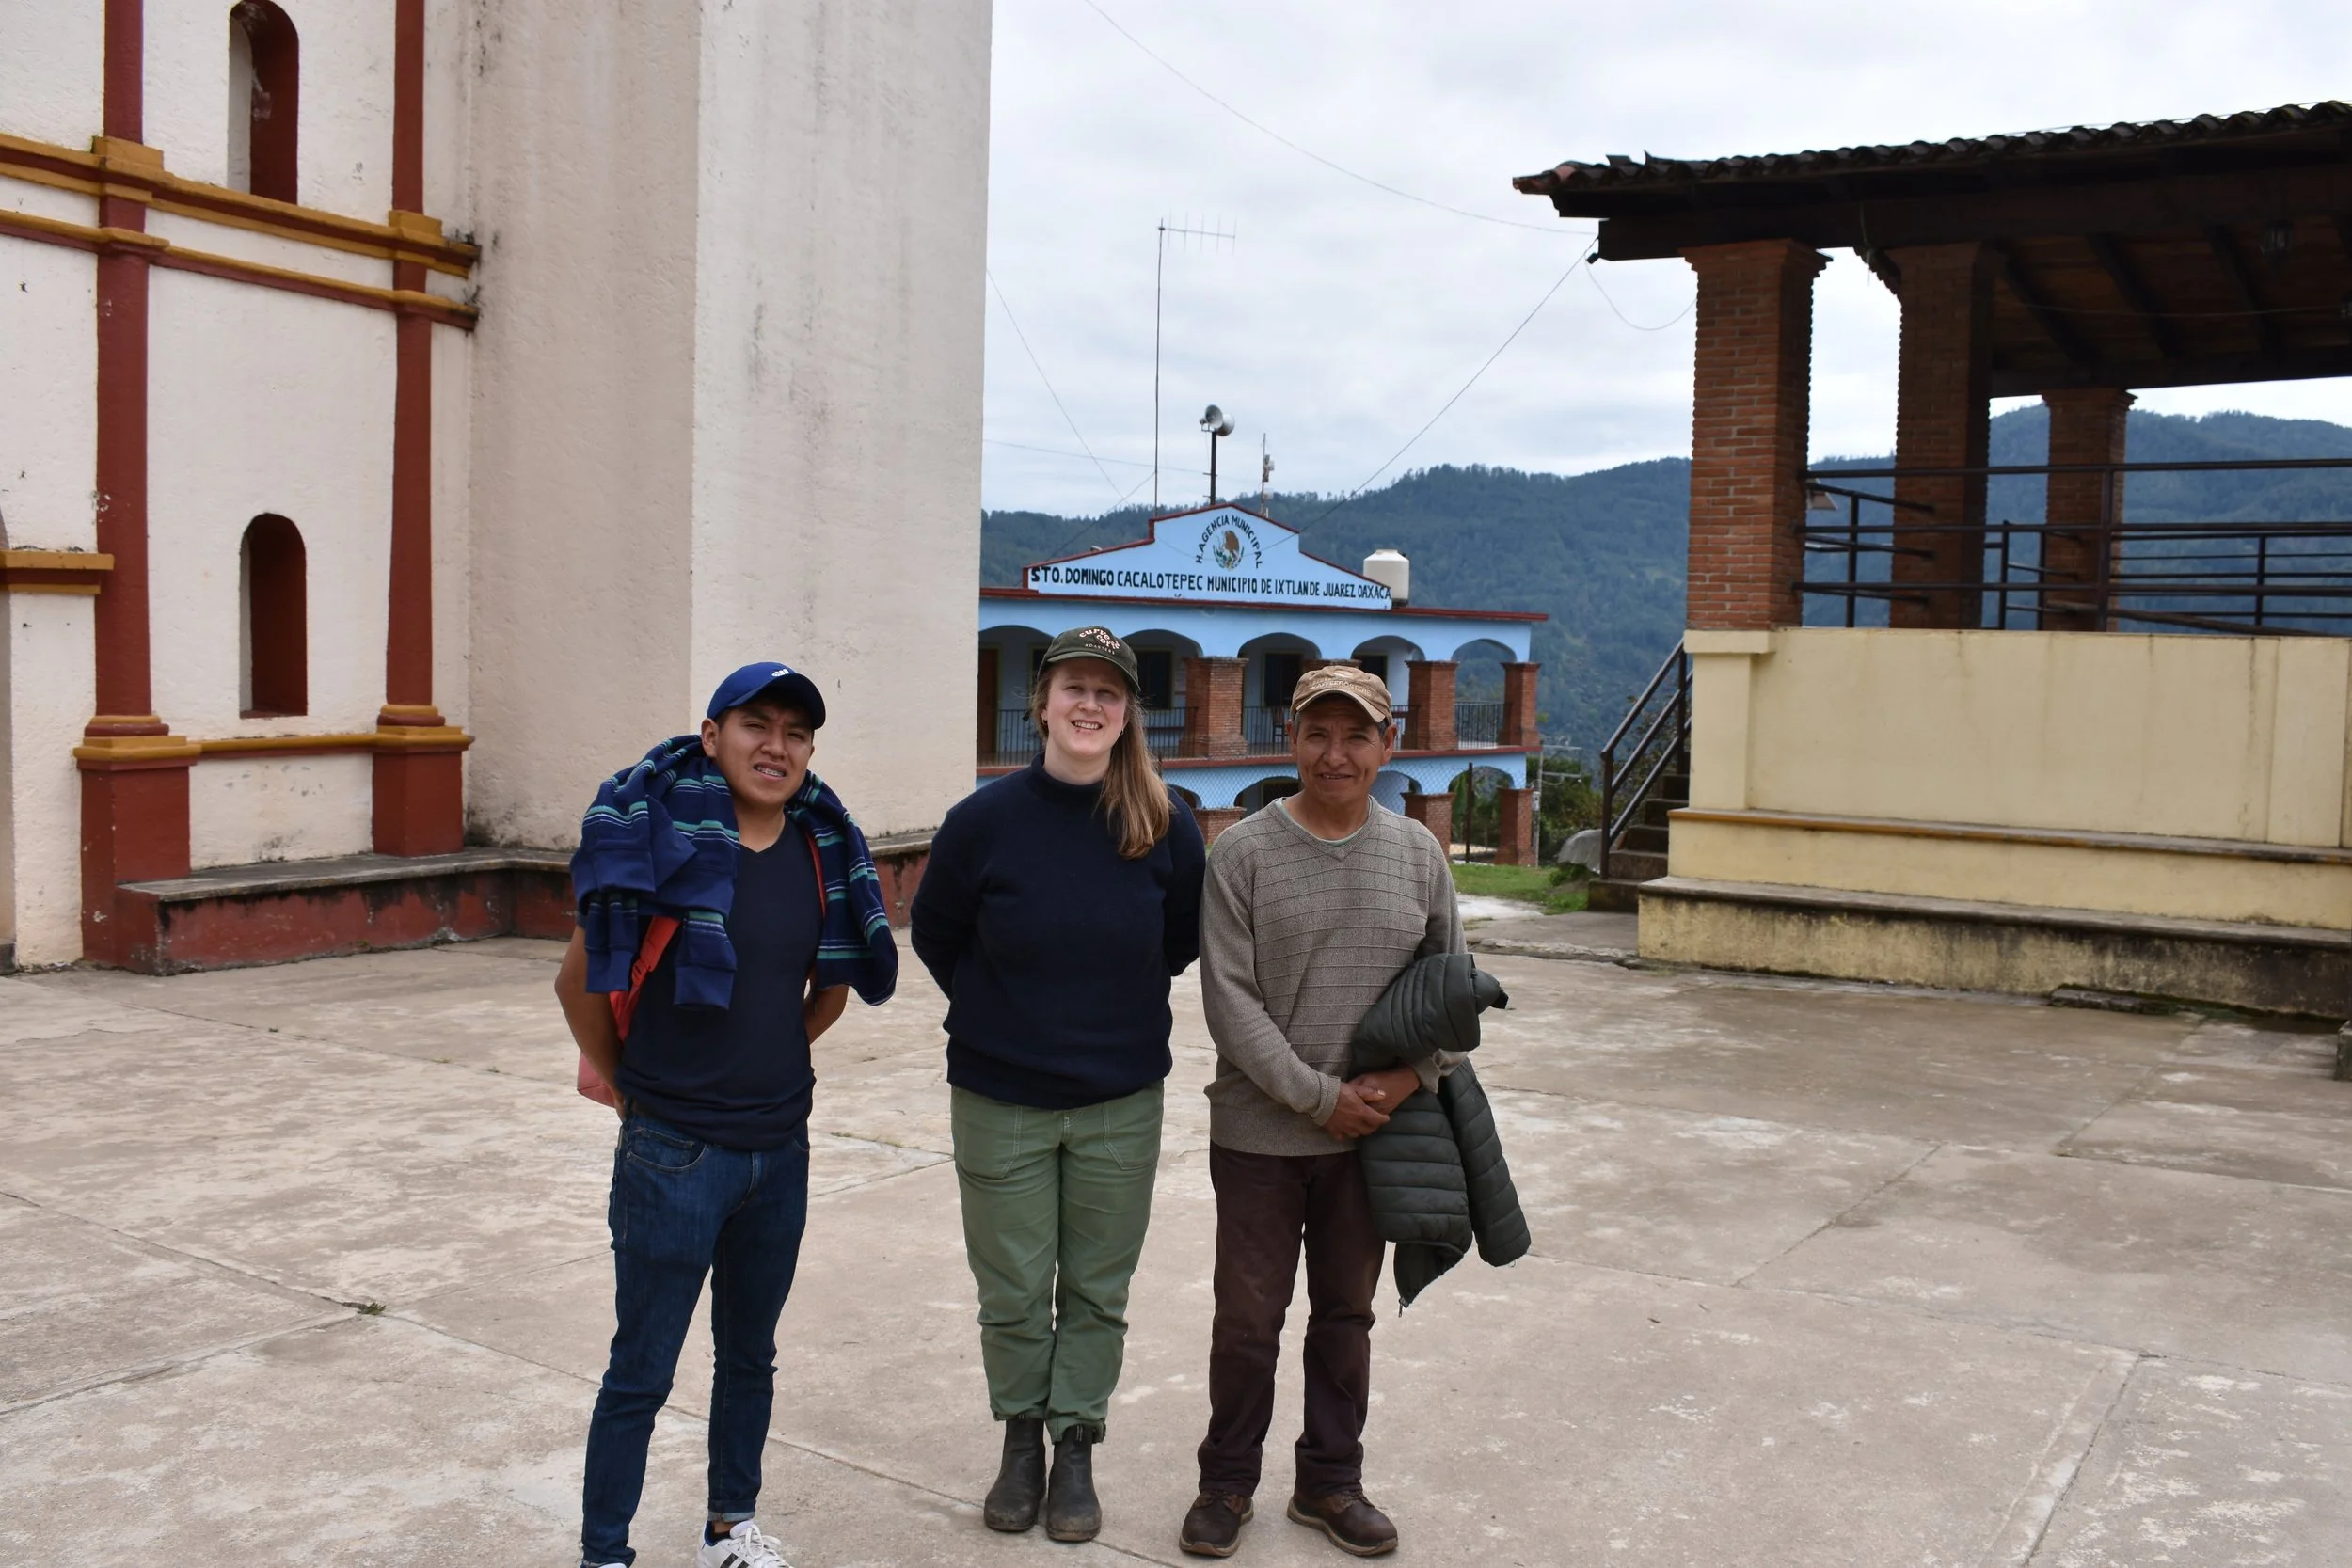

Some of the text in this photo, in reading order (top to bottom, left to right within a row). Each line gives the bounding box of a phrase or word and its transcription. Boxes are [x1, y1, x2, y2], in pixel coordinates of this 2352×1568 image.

[1232, 515, 1263, 569] MUNICIPAL
[1031, 566, 1063, 584] STO.
[1065, 567, 1114, 587] DOMINGO
[1117, 570, 1204, 592] CACALOTEPEC
[1207, 576, 1257, 594] MUNICIPIO
[1261, 579, 1272, 594] DE
[1323, 583, 1356, 598] JUAREZ
[1358, 585, 1392, 600] OAXACA
